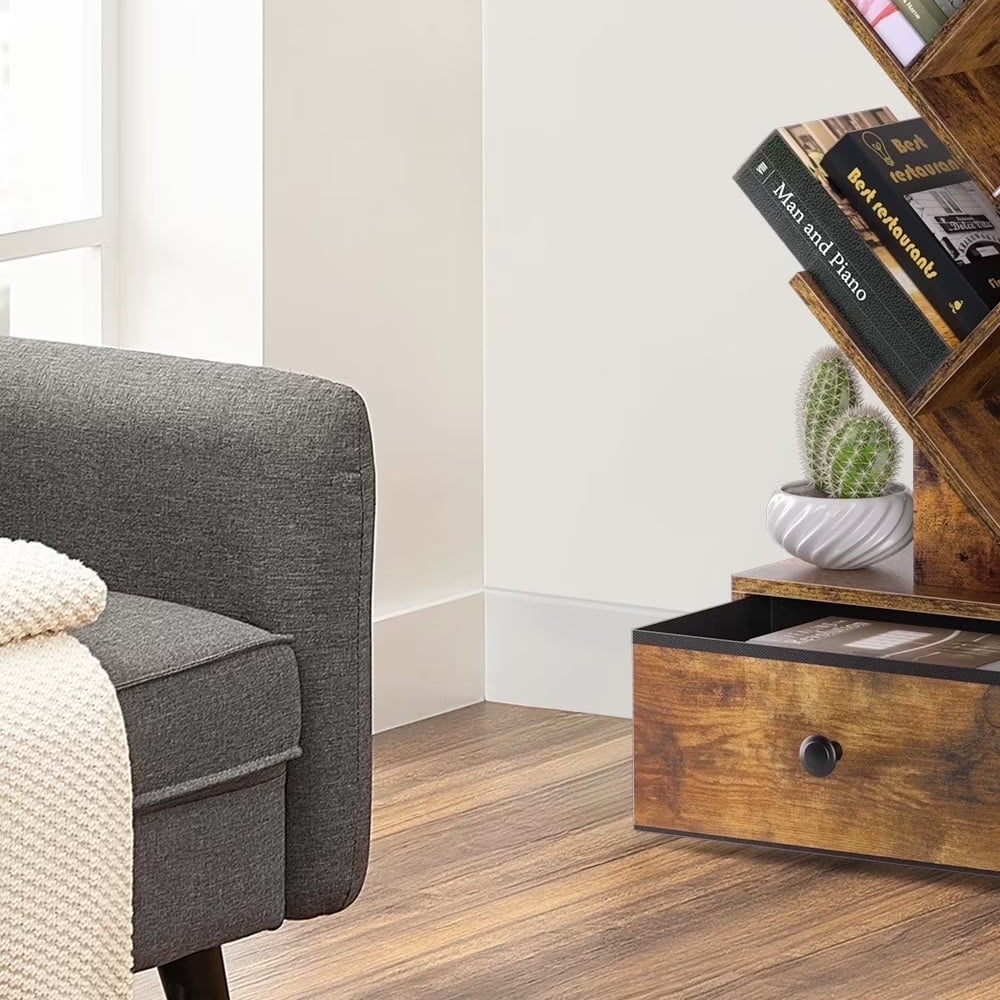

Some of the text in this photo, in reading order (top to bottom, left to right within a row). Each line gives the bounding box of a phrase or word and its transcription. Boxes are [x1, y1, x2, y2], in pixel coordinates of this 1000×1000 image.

[905, 1, 922, 20] Name
[891, 134, 928, 154] Best
[773, 181, 867, 301] Man and Piano
[847, 167, 938, 280] Best restaurants
